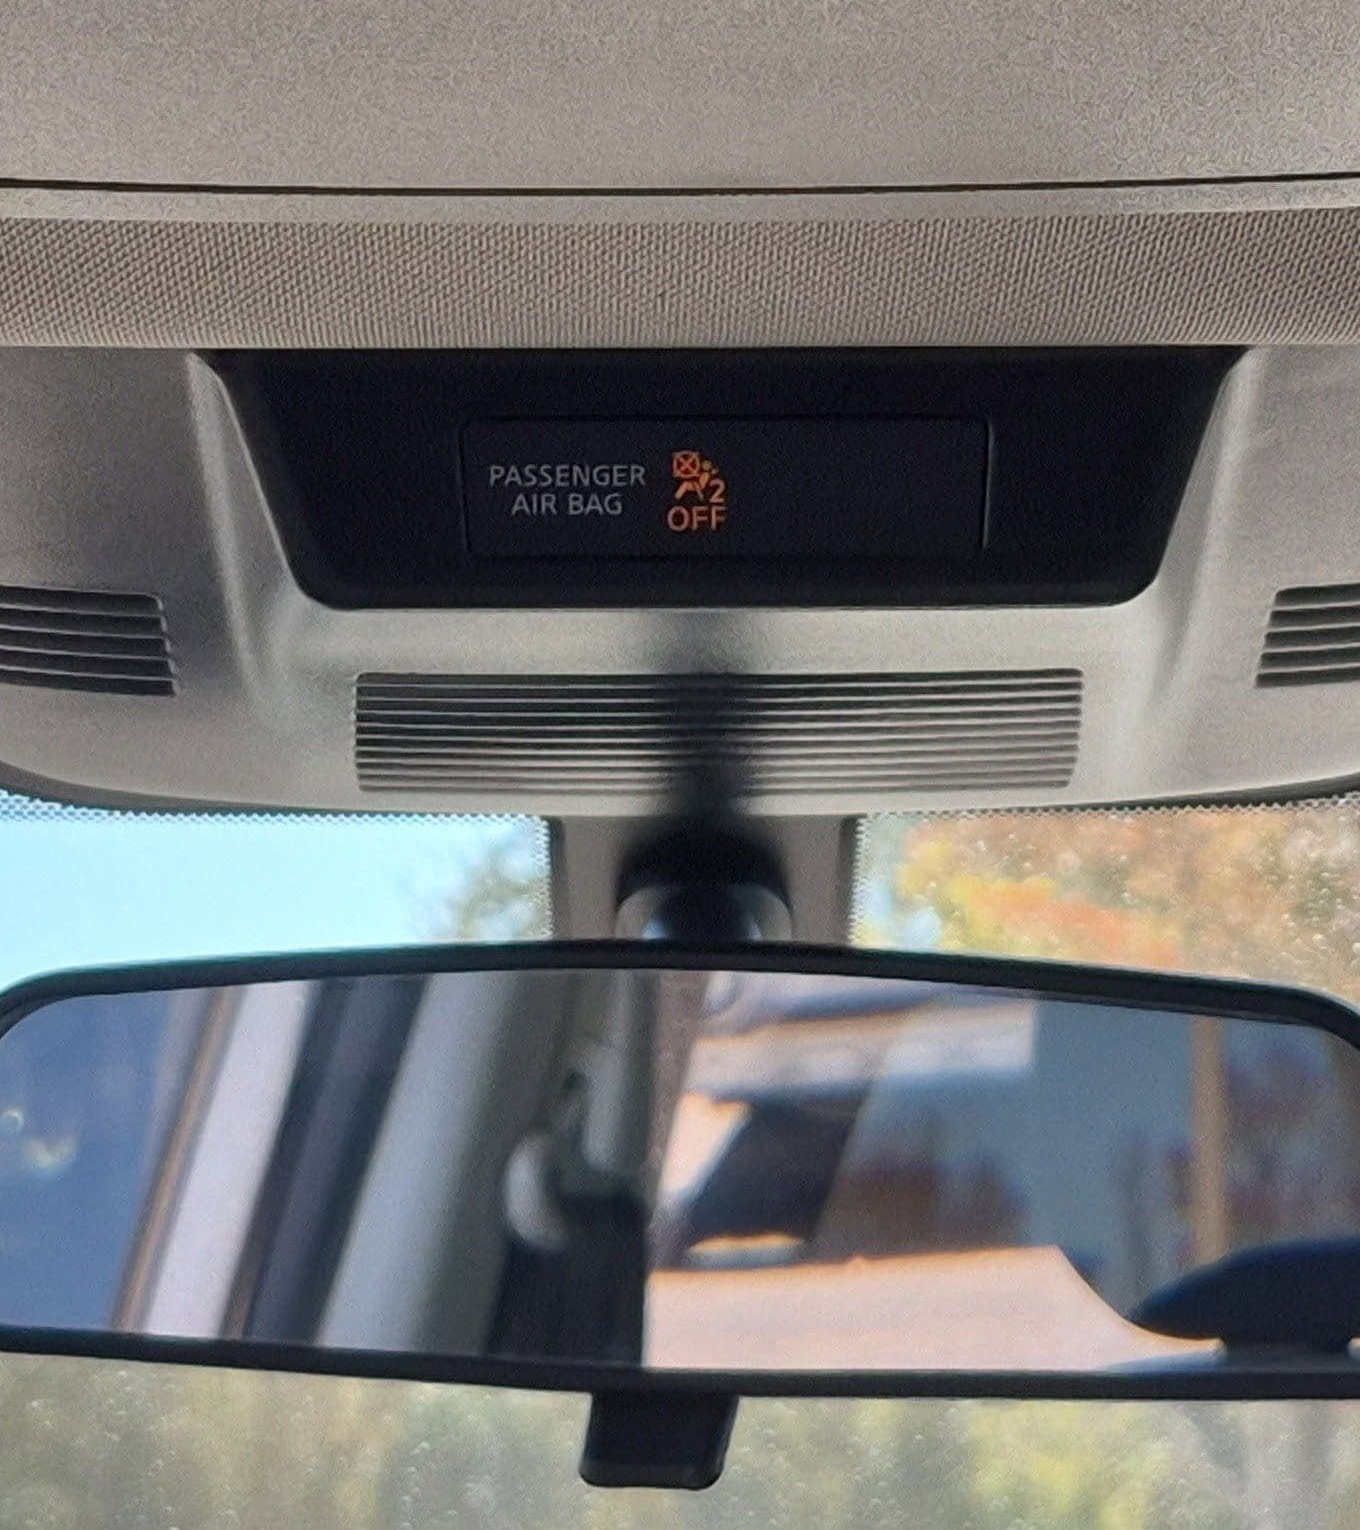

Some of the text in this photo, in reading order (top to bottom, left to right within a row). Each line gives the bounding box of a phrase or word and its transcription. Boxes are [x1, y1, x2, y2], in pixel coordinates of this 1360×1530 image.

[488, 464, 647, 488] PASSENGER
[510, 492, 623, 516] AIR BAG
[666, 505, 728, 532] OFF
